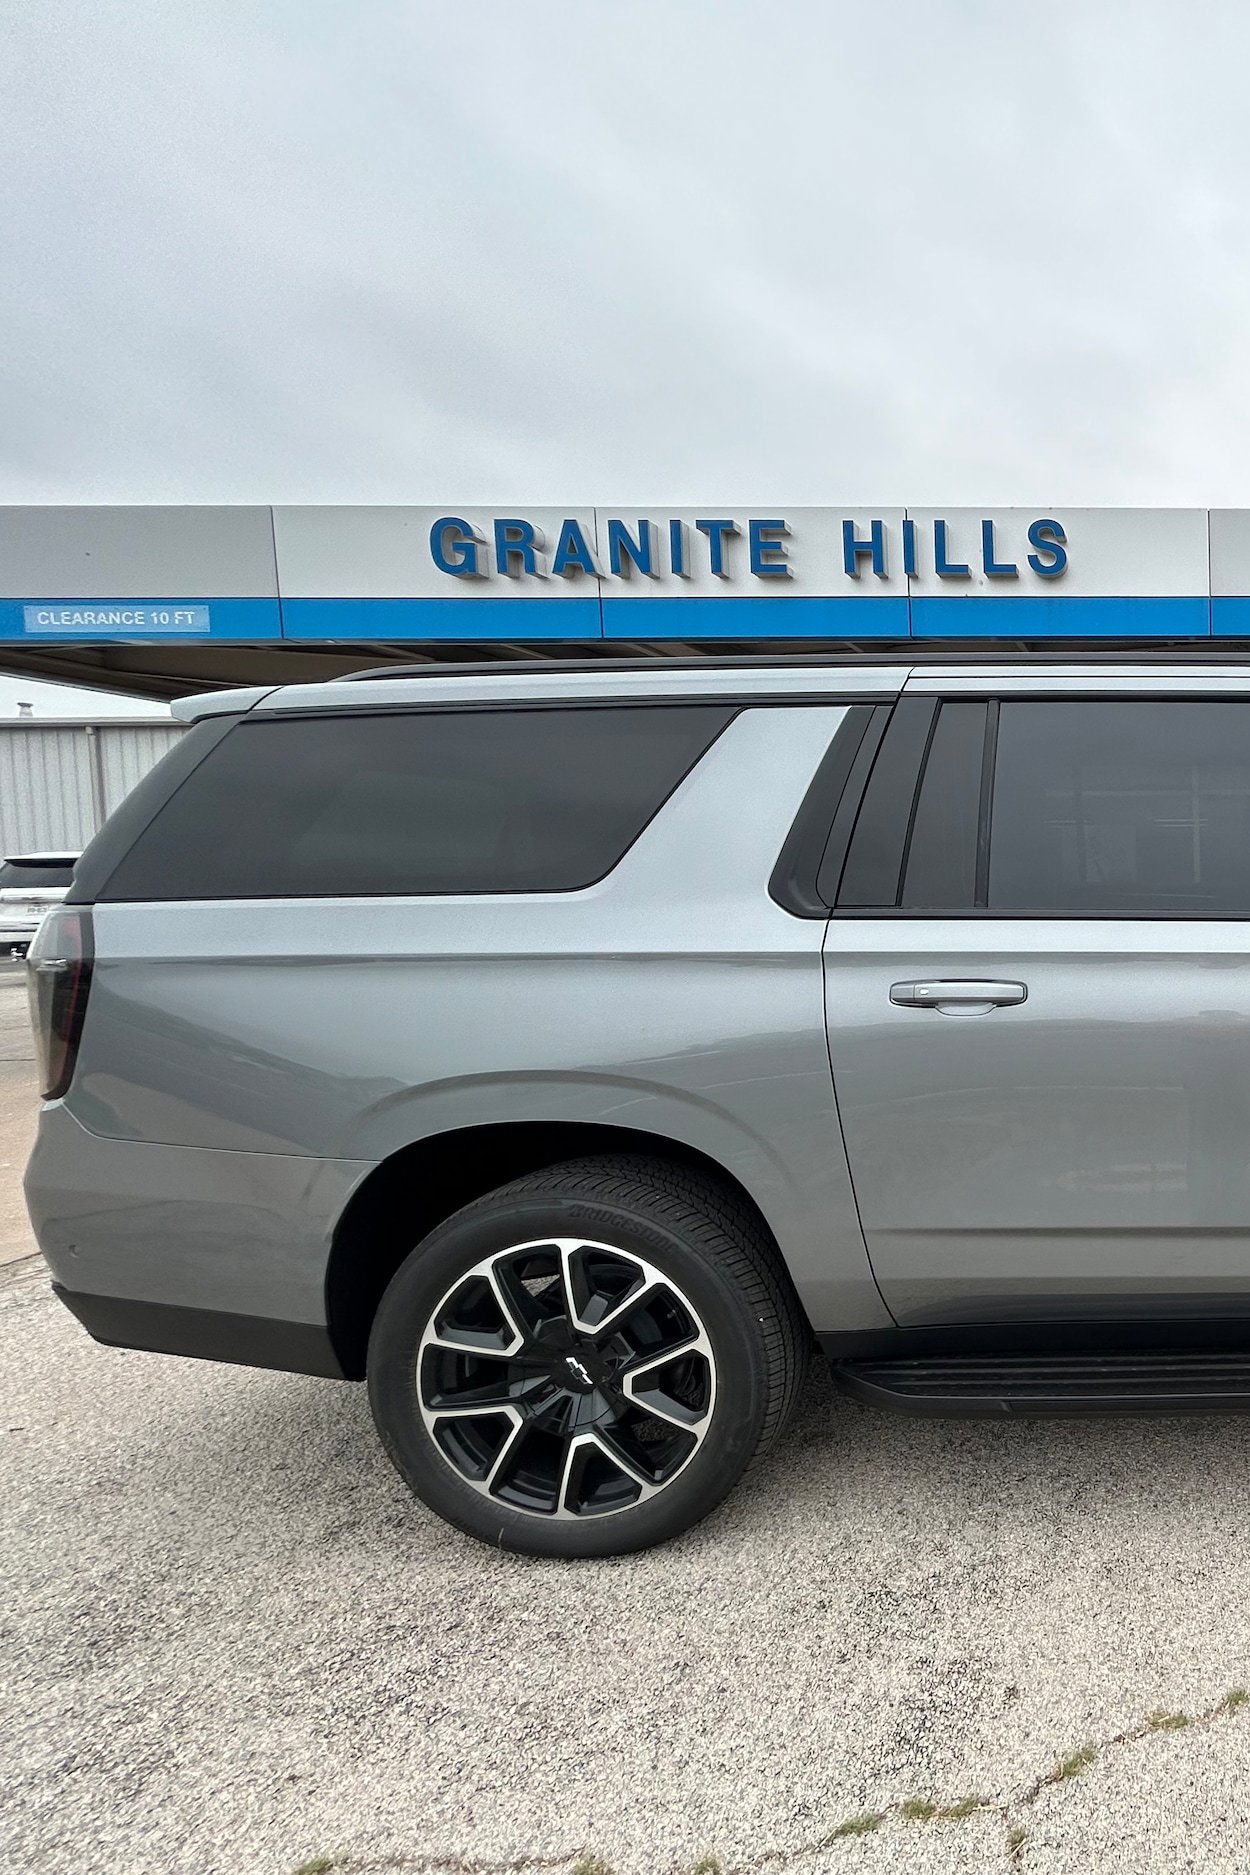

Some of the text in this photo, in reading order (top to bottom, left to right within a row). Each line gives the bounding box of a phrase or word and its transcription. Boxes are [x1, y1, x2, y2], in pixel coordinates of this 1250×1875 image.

[429, 516, 1067, 582] GRANITE HILLS
[36, 611, 195, 625] CLEARANCE 10 FT
